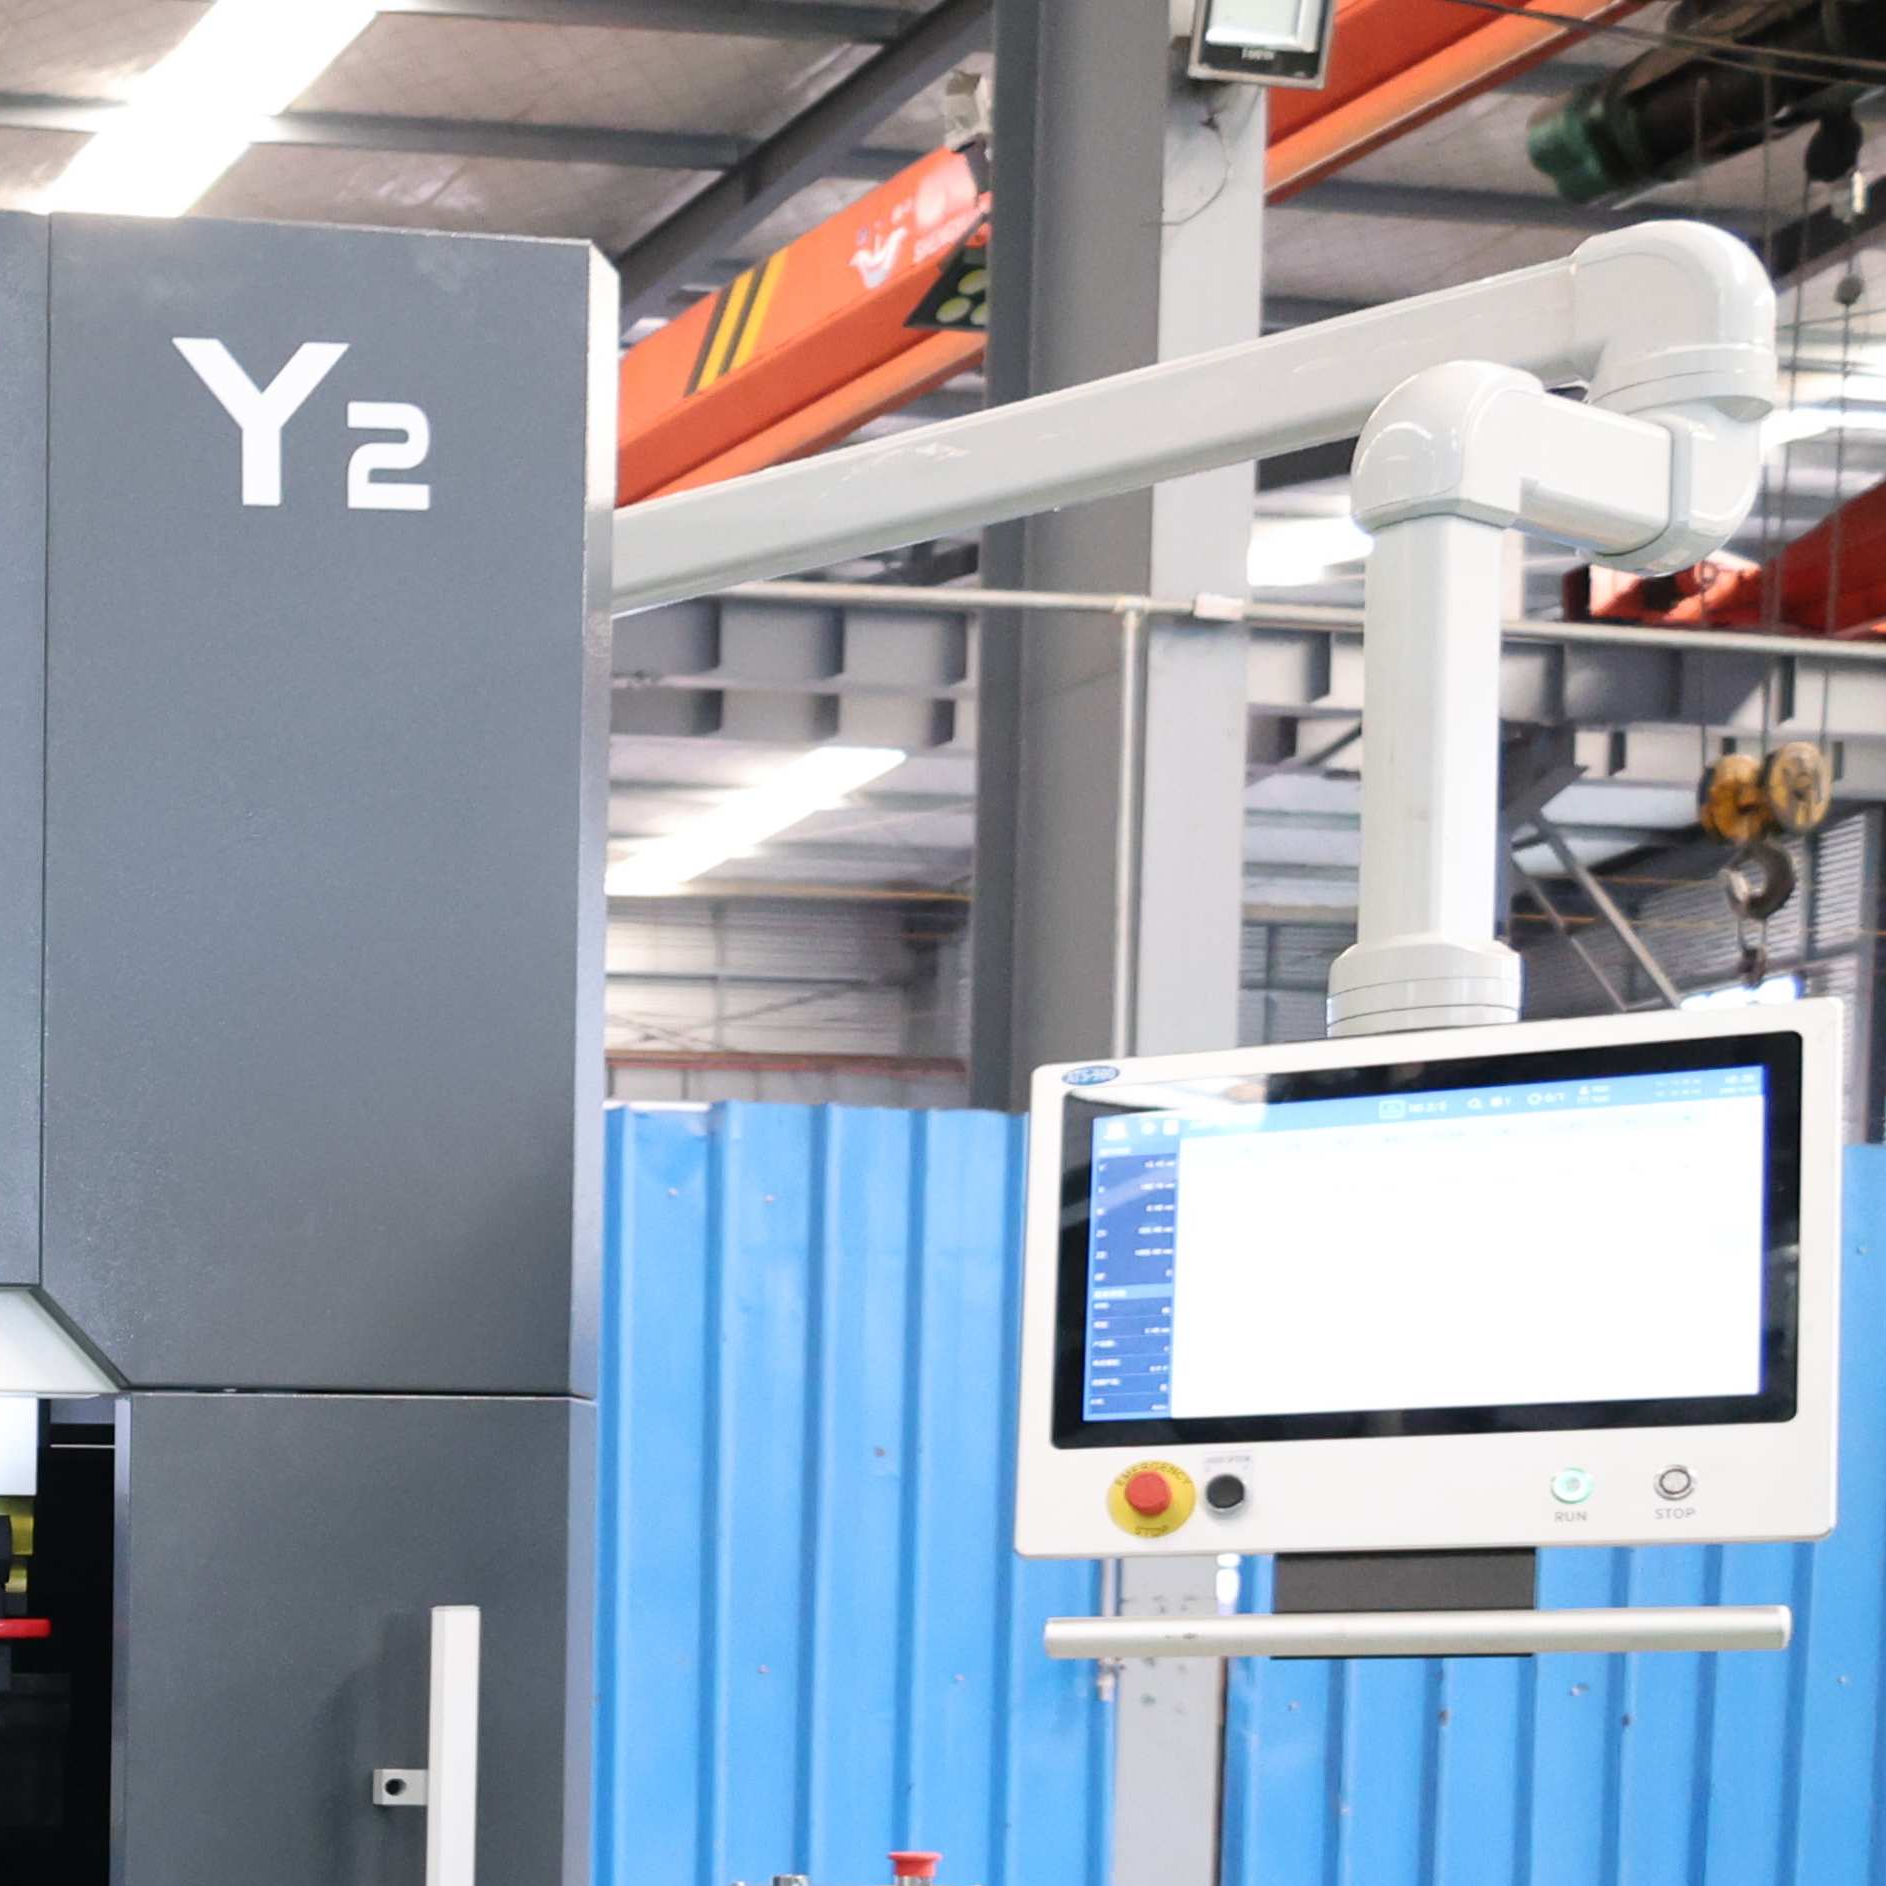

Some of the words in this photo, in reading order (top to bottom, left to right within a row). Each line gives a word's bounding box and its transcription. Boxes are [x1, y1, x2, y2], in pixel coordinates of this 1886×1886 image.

[172, 336, 430, 511] Y2
[1554, 1510, 1588, 1523] RUN
[1654, 1507, 1696, 1520] STOP
